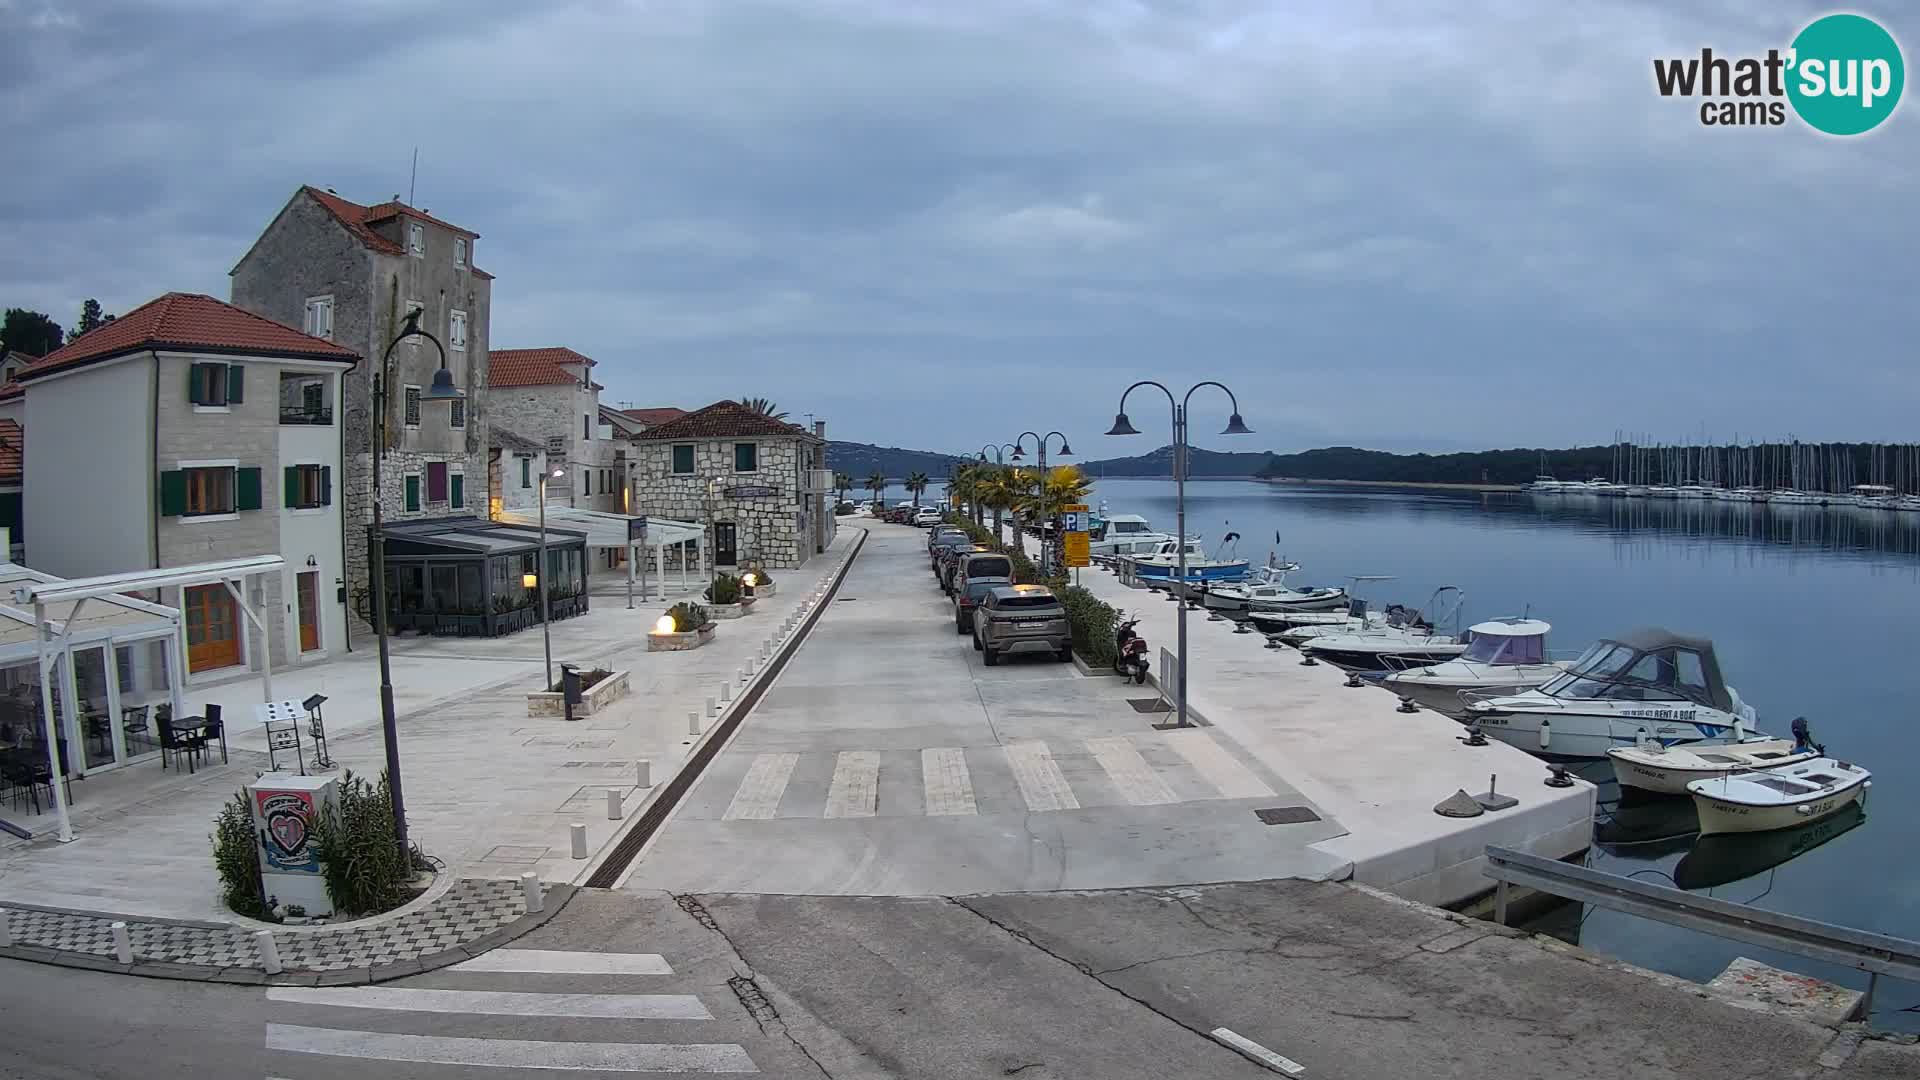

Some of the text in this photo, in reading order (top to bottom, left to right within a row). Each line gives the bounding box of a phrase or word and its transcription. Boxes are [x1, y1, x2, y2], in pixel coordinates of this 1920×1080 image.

[1066, 514, 1077, 530] P
[1654, 709, 1673, 719] RENT
[1673, 710, 1679, 719] A
[1679, 710, 1697, 721] BOAT
